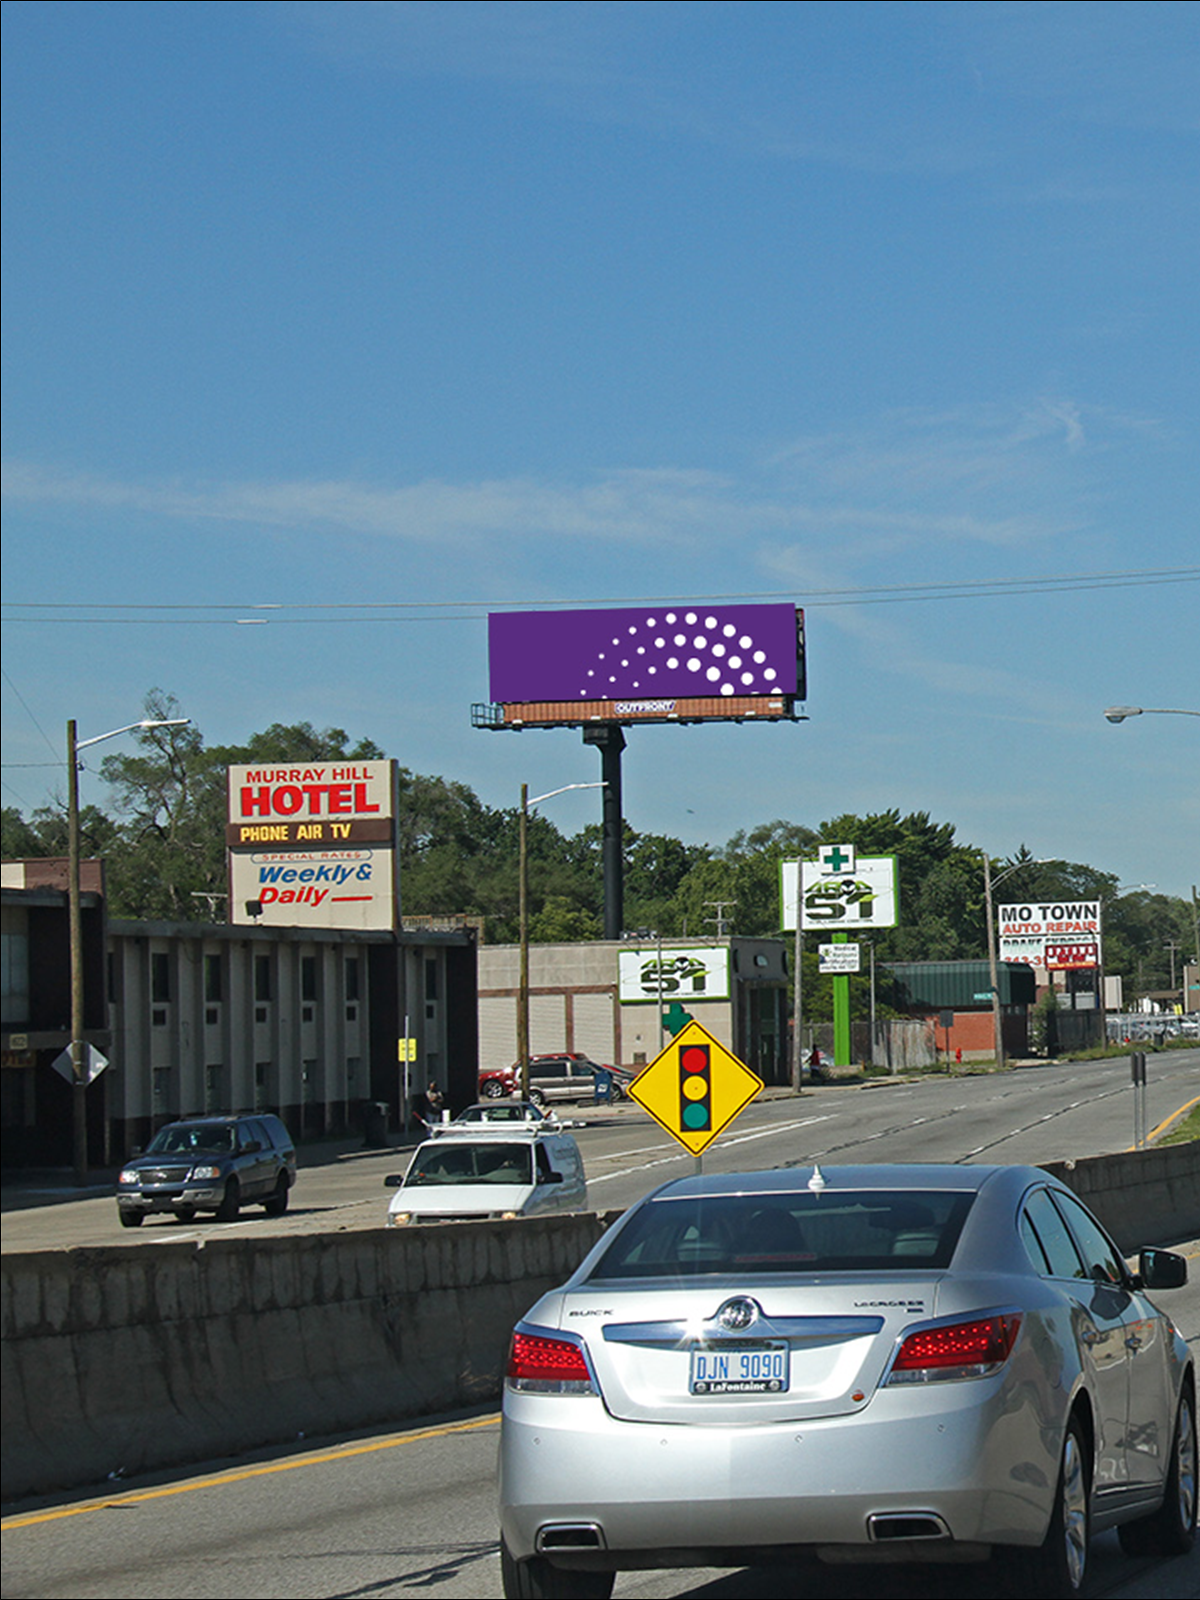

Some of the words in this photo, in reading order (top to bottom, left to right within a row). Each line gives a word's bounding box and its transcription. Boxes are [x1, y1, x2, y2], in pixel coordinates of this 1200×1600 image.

[246, 768, 326, 784] MURRAY
[332, 767, 374, 781] HILL
[240, 783, 380, 817] HOTEL
[240, 825, 289, 842] PHONE
[296, 823, 323, 841] AIR
[330, 823, 352, 839] TV
[262, 853, 315, 861] SPECIAL
[321, 851, 361, 860] RATES
[259, 886, 329, 907] Daily
[1001, 906, 1032, 921] MO
[1038, 904, 1097, 920] TOWN
[1003, 923, 1042, 934] AUTO
[1046, 921, 1097, 932] REPAIR
[696, 1356, 729, 1379] DJN
[740, 1354, 783, 1378] 9090
[710, 1381, 766, 1392] LaFontaine
